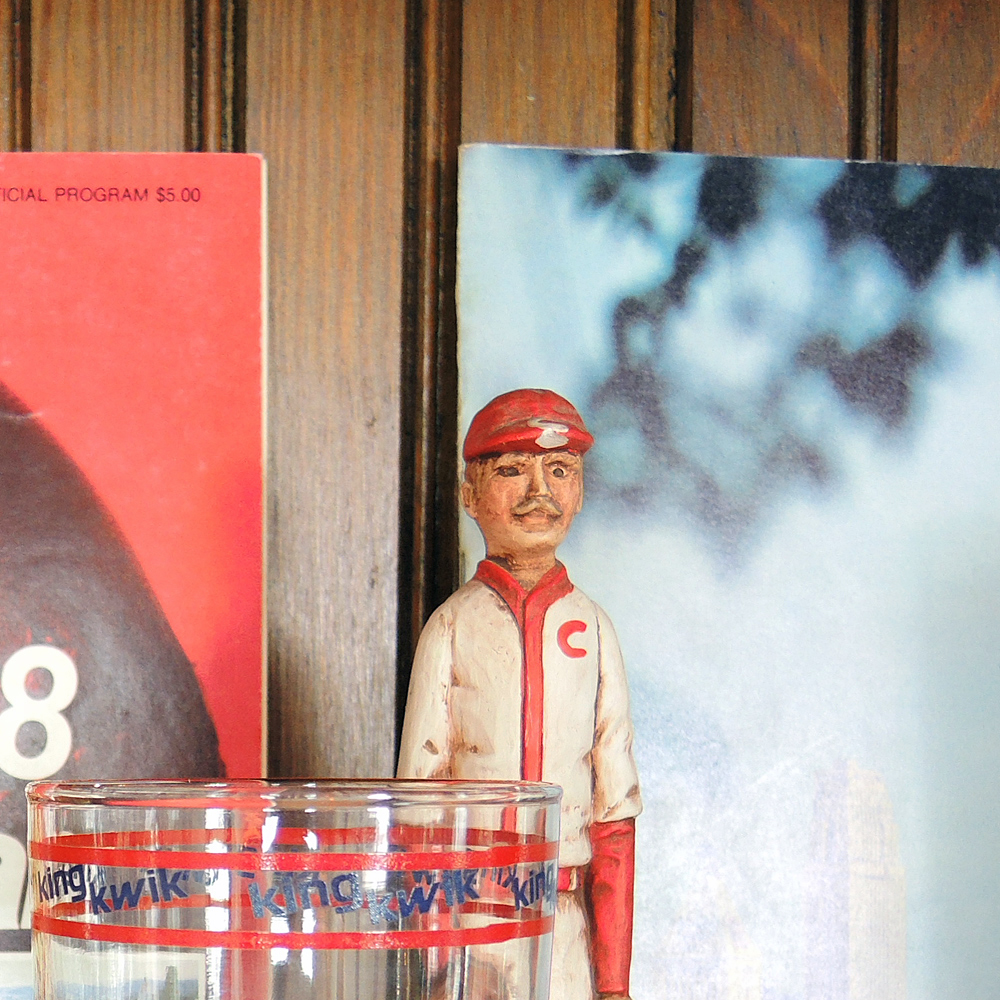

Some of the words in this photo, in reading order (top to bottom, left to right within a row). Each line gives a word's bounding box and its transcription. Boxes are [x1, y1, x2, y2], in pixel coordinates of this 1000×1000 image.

[55, 187, 148, 202] PROGRAM
[156, 186, 201, 203] $5.00
[557, 620, 587, 658] C
[37, 864, 87, 903] king
[88, 868, 188, 916] kwik
[248, 872, 363, 918] king
[366, 868, 480, 926] kwik
